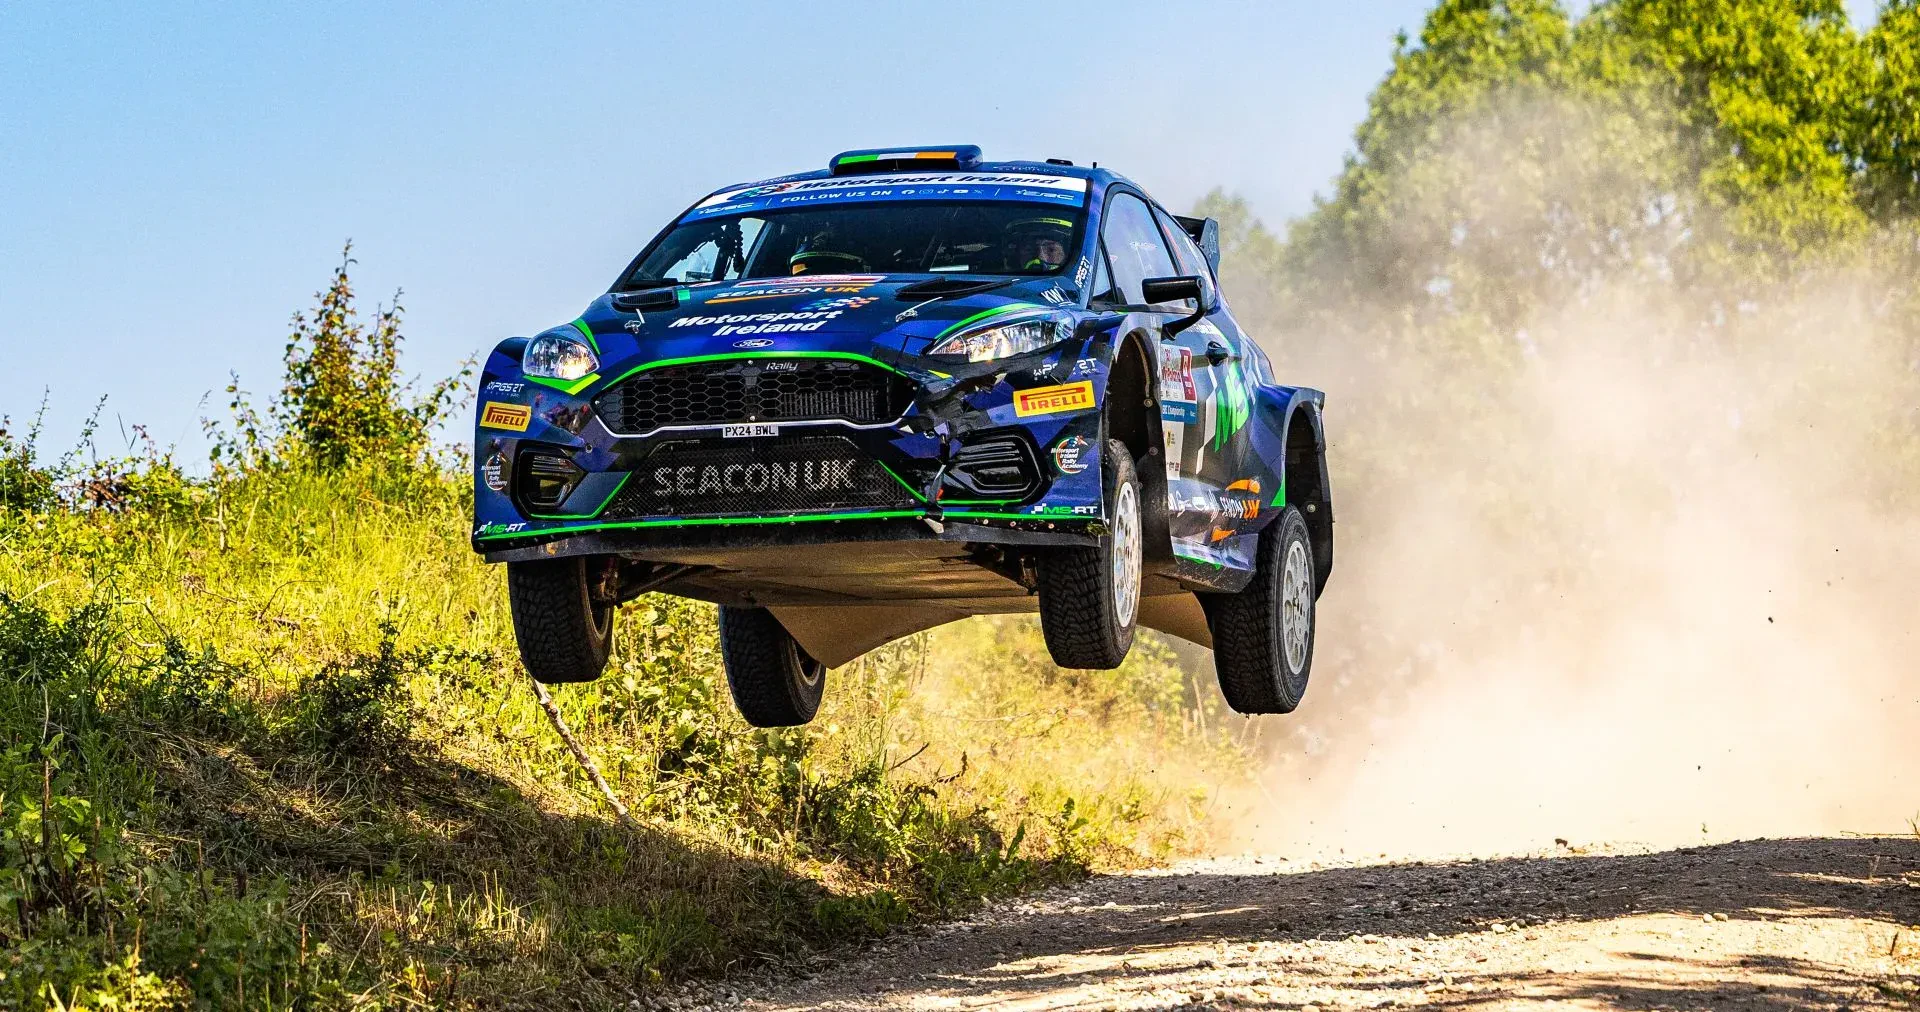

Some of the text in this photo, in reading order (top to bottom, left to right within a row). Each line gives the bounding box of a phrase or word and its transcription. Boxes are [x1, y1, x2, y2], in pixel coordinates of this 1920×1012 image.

[800, 175, 952, 190] Motorsport
[956, 175, 1062, 185] Ireland
[781, 193, 842, 203] FOLLOW
[714, 287, 822, 298] SEACON
[668, 310, 843, 328] Motorsport
[712, 320, 828, 336] Ireland
[738, 339, 766, 348] Ford
[766, 362, 800, 371] Rally
[1020, 386, 1086, 411] PIRELLI
[485, 406, 527, 426] PIRELLI
[725, 426, 775, 436] PX24 BWL
[654, 459, 855, 496] SEACON UK
